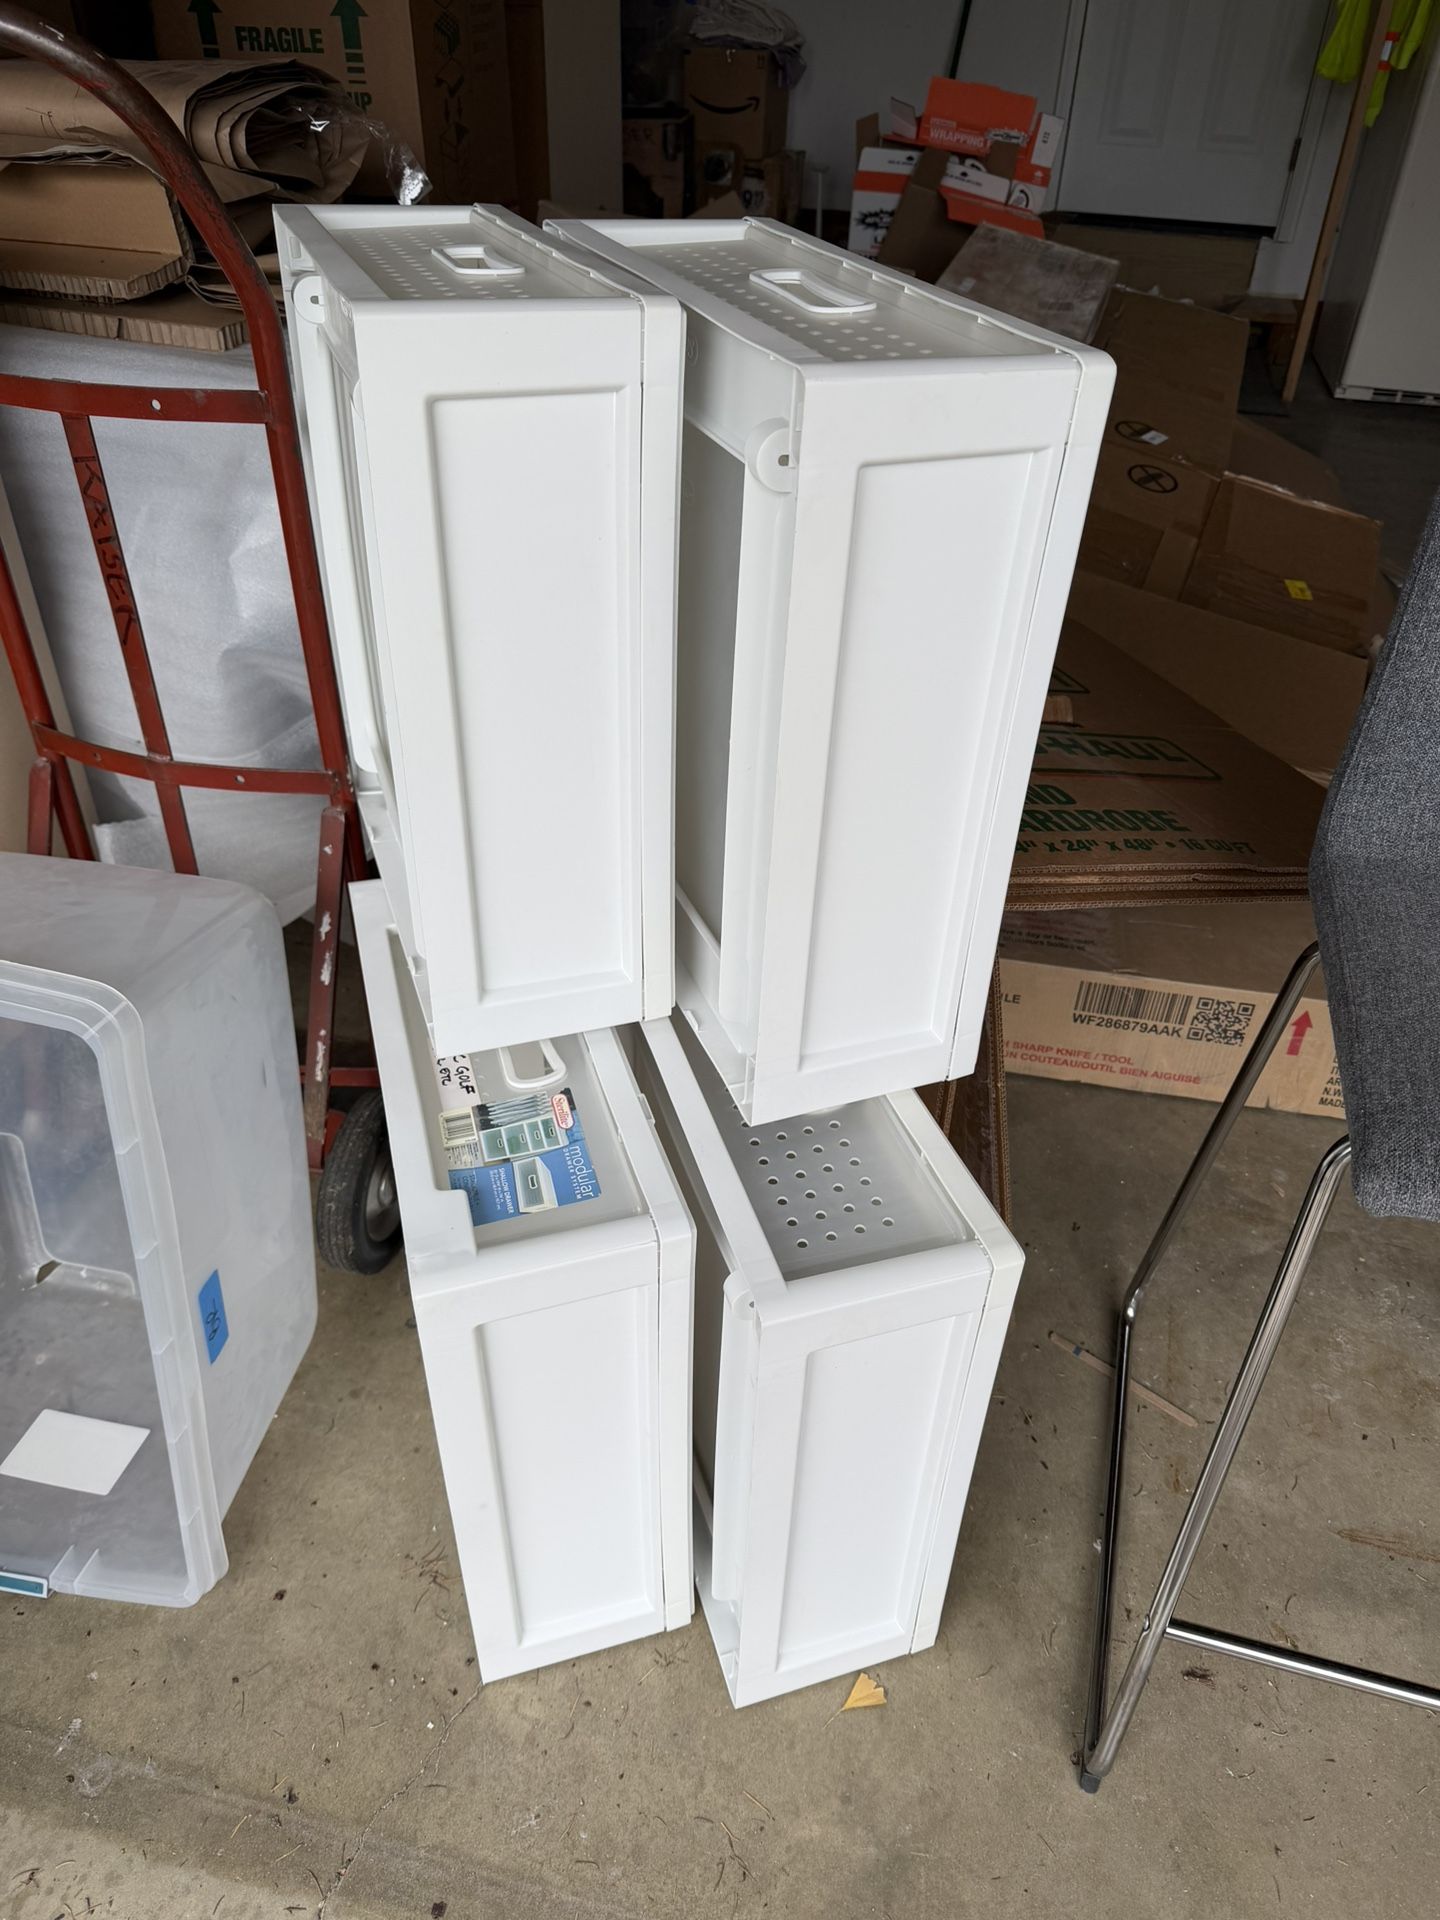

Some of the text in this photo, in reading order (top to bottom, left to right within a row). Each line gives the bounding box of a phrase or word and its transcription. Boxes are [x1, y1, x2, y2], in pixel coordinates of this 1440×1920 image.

[234, 26, 325, 54] FRAGILE
[930, 127, 985, 149] WRAPPING
[73, 456, 137, 646] KAISER
[1036, 736, 1188, 761] -HAUL
[1019, 809, 1193, 832] ARDROBE
[1072, 1013, 1184, 1038] WF286879AAK
[1013, 1041, 1054, 1053] SHARP
[1056, 1047, 1091, 1059] KNIFE
[1101, 1053, 1134, 1066] TOOL
[1020, 1053, 1117, 1073] COUTEAU/OUTIL
[1119, 1067, 1148, 1078] BIEN
[554, 1096, 570, 1125] Sterilite
[563, 1148, 582, 1200] DRAWER SYSTEM
[569, 1145, 596, 1198] modular
[503, 1191, 515, 1214] DRAWER
